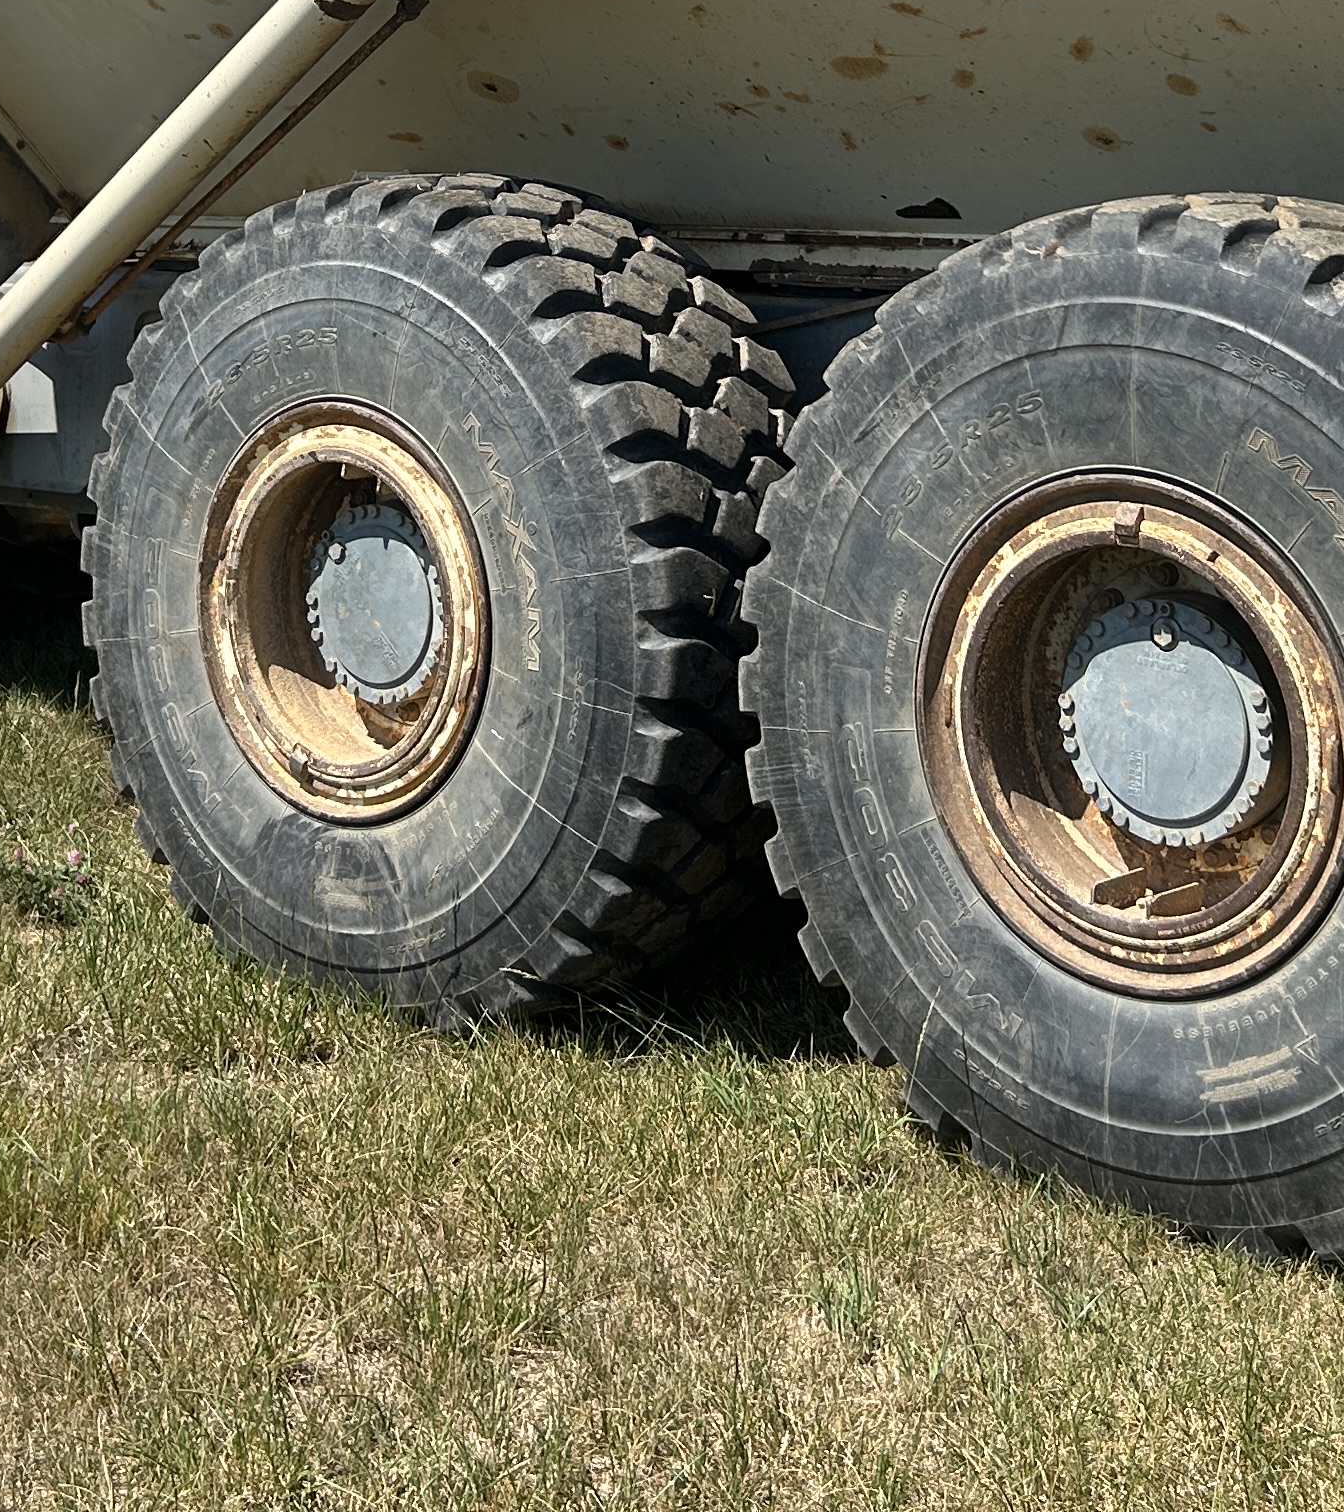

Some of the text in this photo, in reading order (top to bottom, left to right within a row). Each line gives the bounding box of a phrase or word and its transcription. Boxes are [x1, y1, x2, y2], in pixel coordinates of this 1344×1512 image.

[462, 412, 541, 672] MAXAM
[842, 721, 1024, 1039] MS302
[1173, 1001, 1282, 1040] TUBELESS
[1282, 955, 1340, 1005] STEEL
